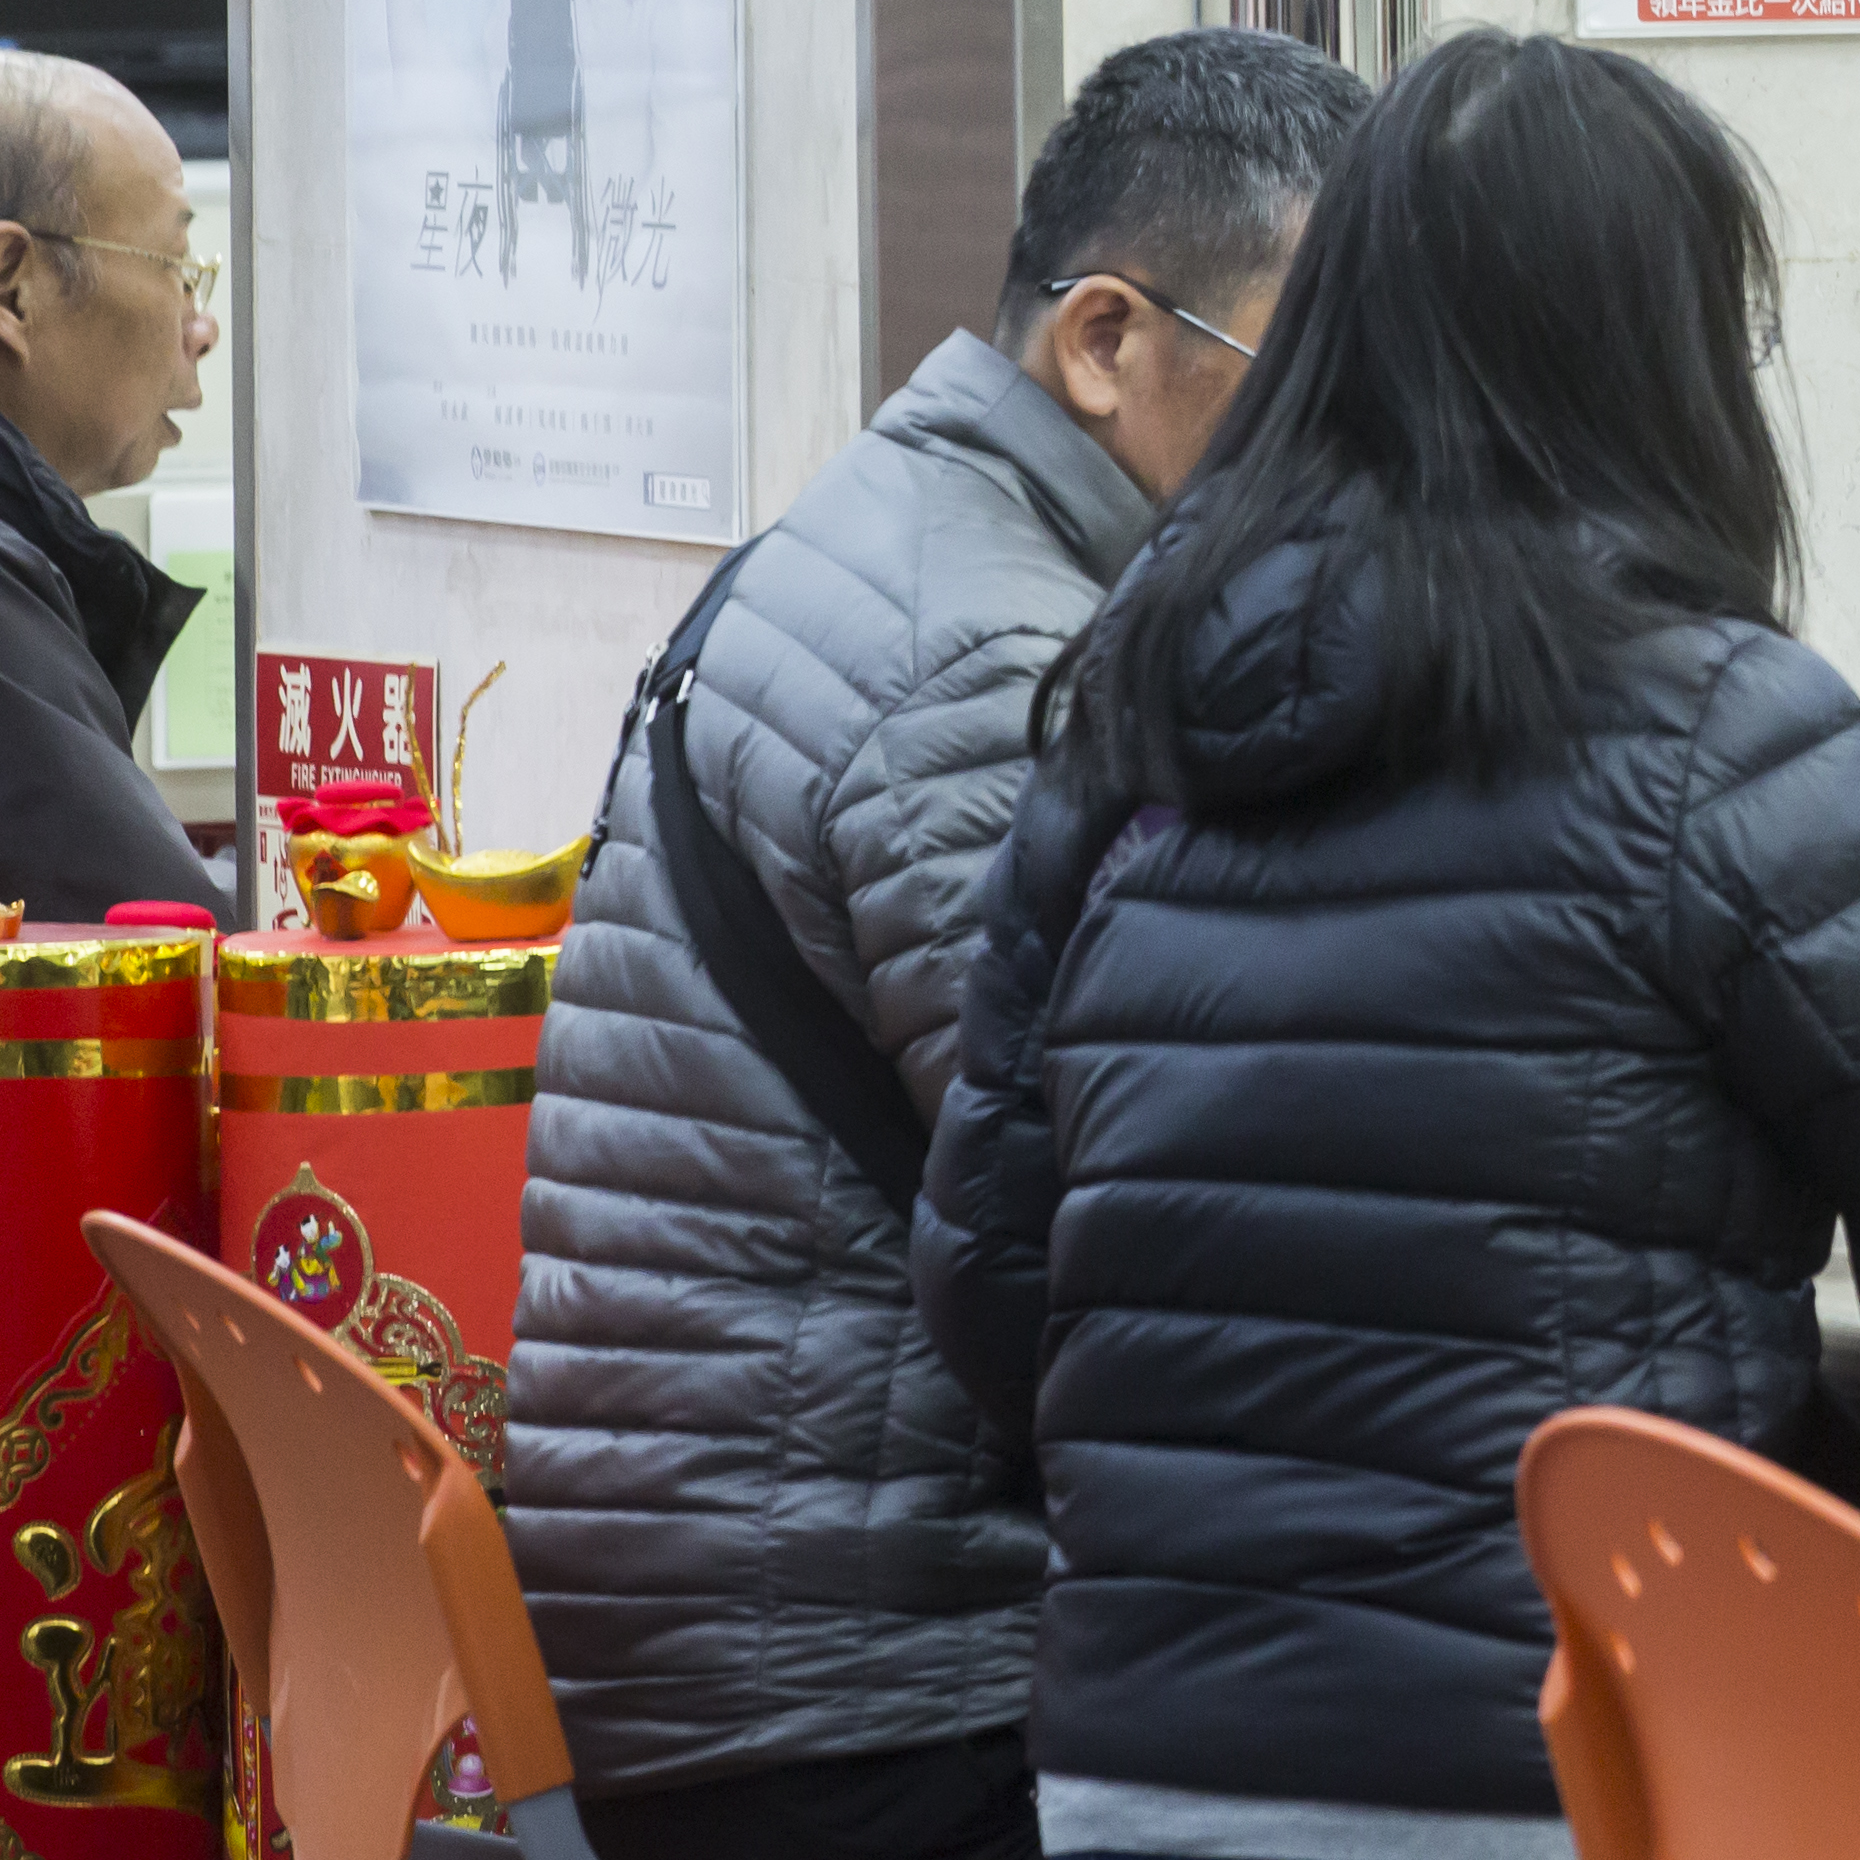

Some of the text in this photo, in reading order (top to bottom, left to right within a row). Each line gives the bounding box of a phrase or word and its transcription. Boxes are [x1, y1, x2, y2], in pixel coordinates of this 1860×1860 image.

[278, 662, 416, 765] 滅火器
[291, 762, 316, 790] FIRE
